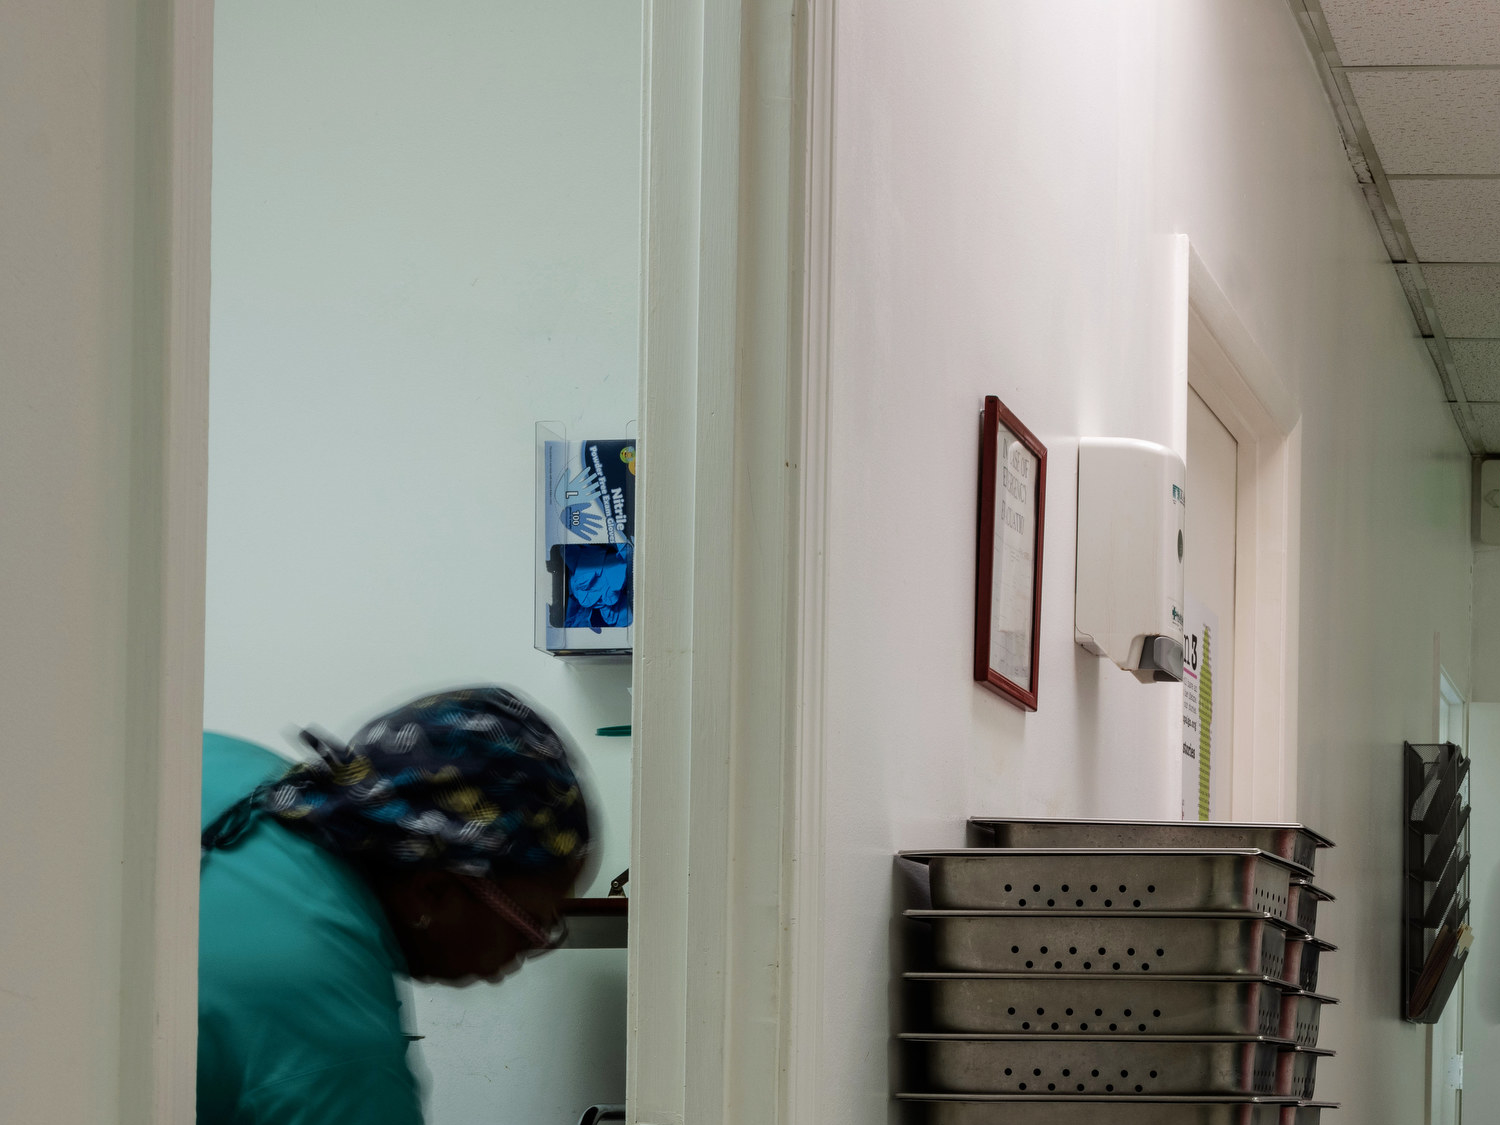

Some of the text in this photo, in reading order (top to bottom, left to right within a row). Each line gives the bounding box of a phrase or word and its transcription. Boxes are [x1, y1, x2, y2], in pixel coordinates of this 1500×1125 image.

[589, 446, 604, 476] Powder
[598, 476, 608, 494] Free
[572, 511, 580, 526] 100
[602, 496, 611, 517] Exam
[611, 488, 627, 531] Nitrile
[1192, 634, 1197, 671] 3
